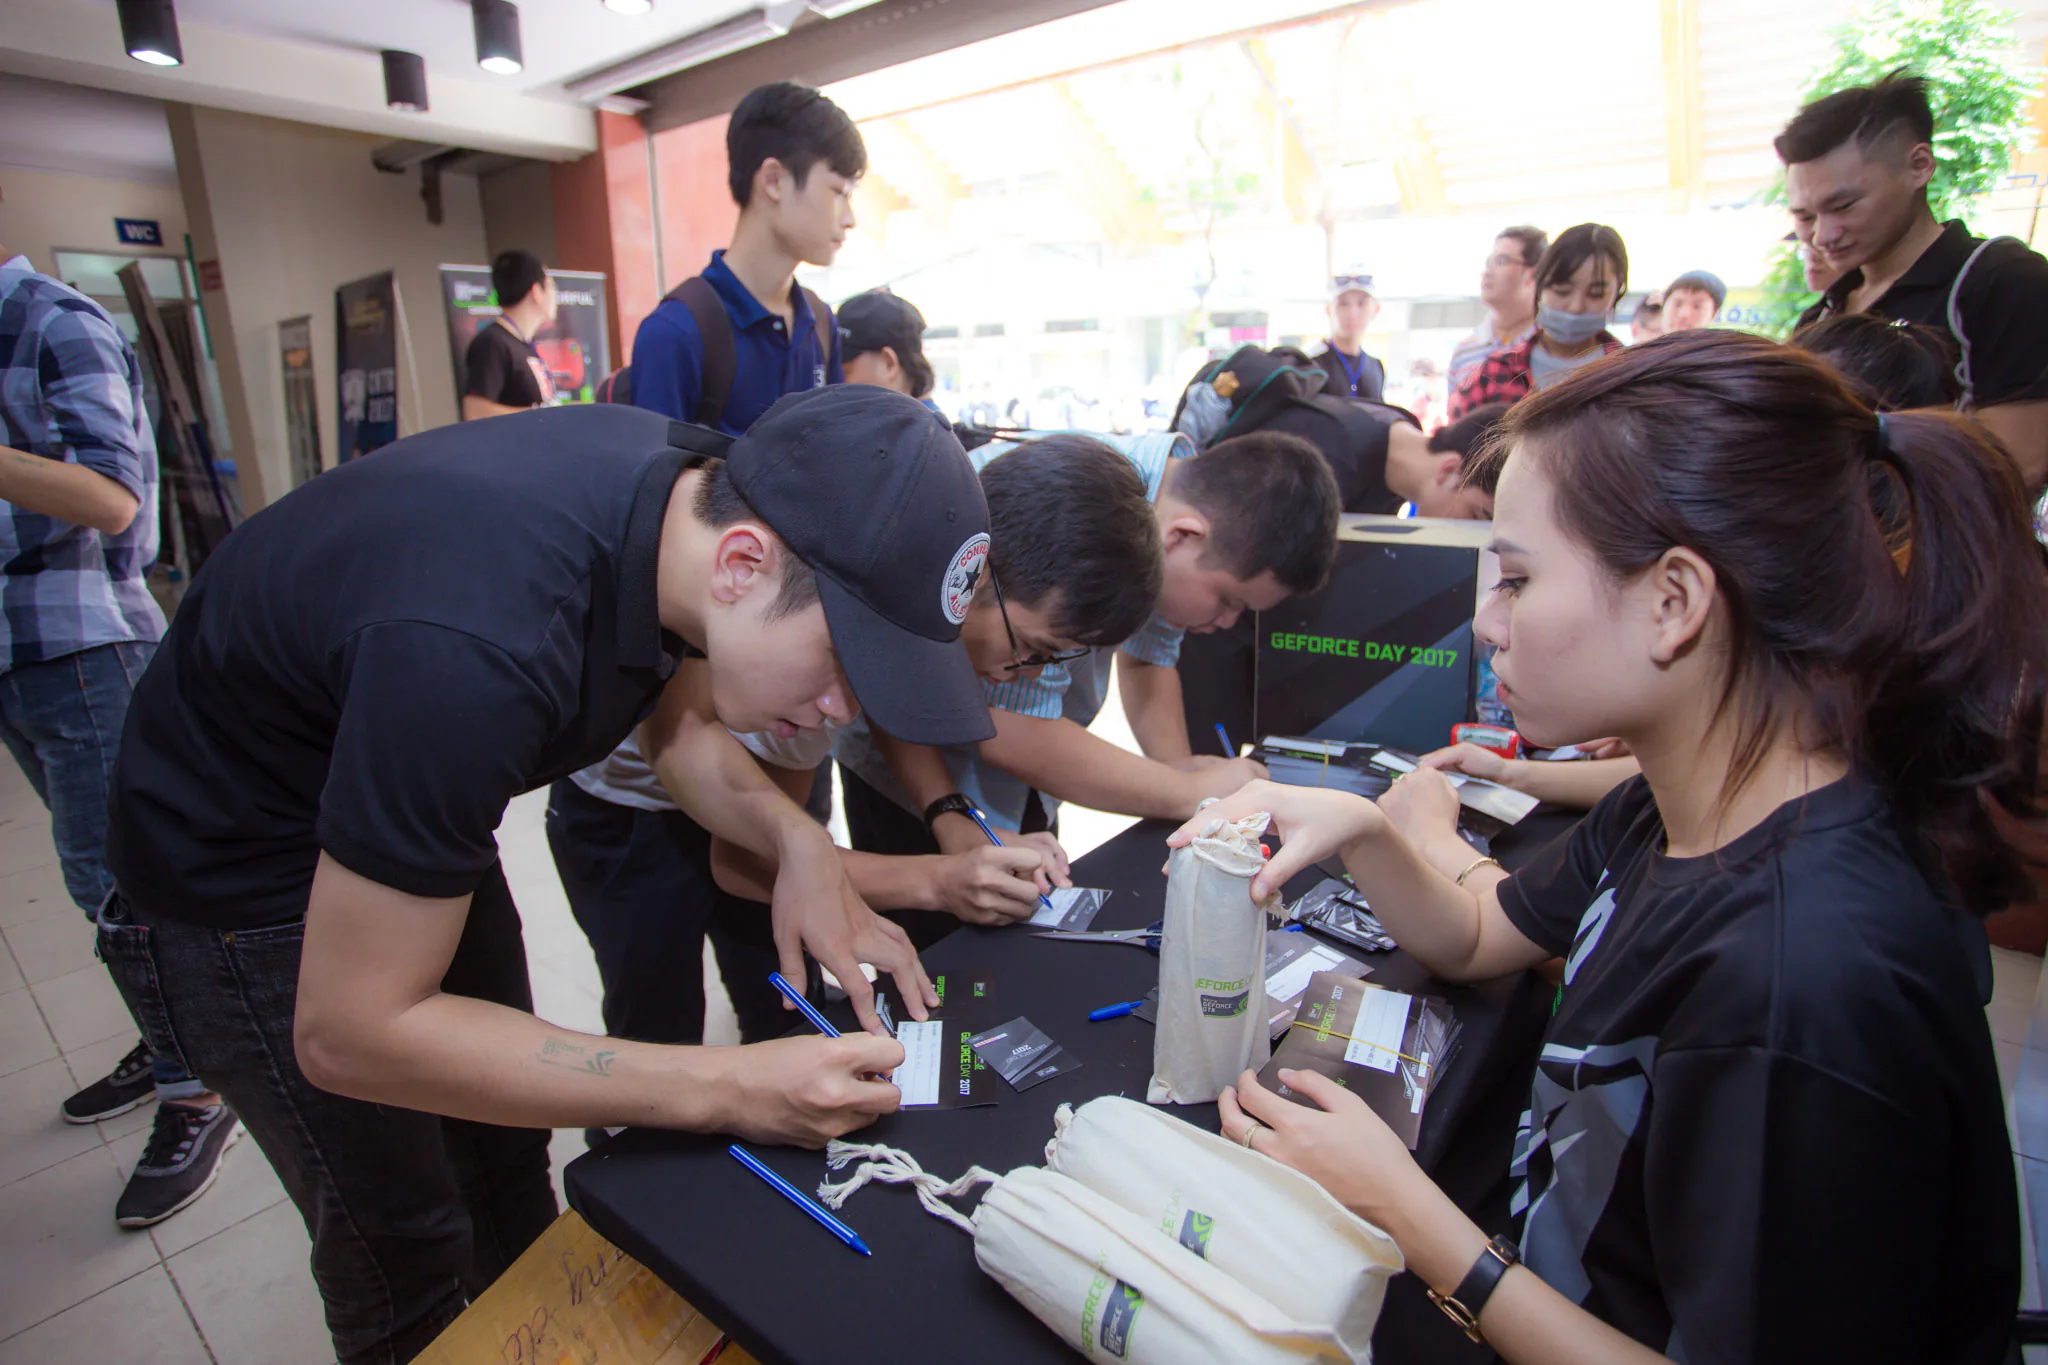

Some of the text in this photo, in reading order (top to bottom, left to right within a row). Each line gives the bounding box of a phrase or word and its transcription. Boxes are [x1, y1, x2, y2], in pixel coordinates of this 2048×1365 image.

[123, 223, 155, 240] WC
[1270, 632, 1458, 668] GEFORCE DAY 2017
[1195, 977, 1245, 991] EFORCE
[1316, 1011, 1335, 1042] GEORCE
[1012, 1044, 1031, 1055] 2017
[959, 1079, 970, 1096] 2017
